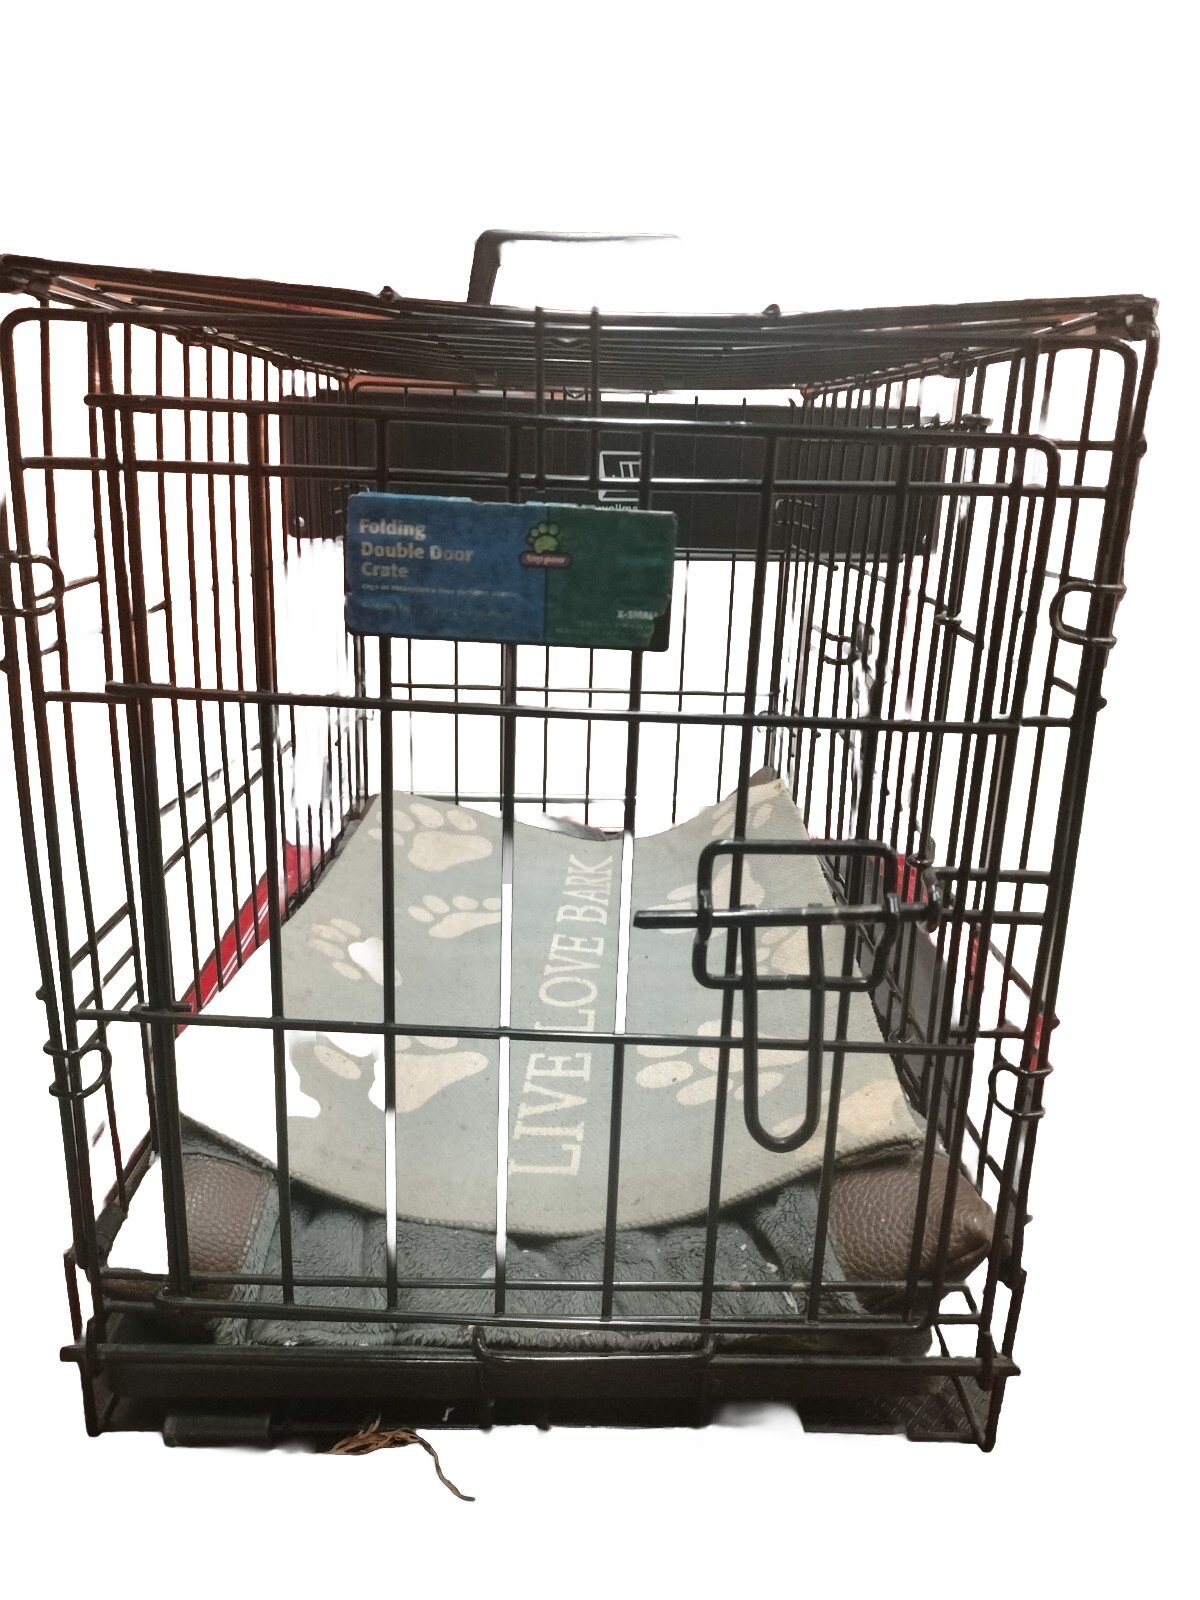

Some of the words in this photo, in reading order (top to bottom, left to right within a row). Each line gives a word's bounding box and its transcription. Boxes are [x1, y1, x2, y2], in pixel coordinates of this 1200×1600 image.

[359, 518, 427, 541] Folding
[360, 541, 424, 559] Double
[430, 545, 474, 562] Door
[361, 561, 408, 578] Crate
[556, 854, 613, 926] BARK
[534, 933, 605, 1033] LOVE
[508, 1052, 592, 1176] LIVE
